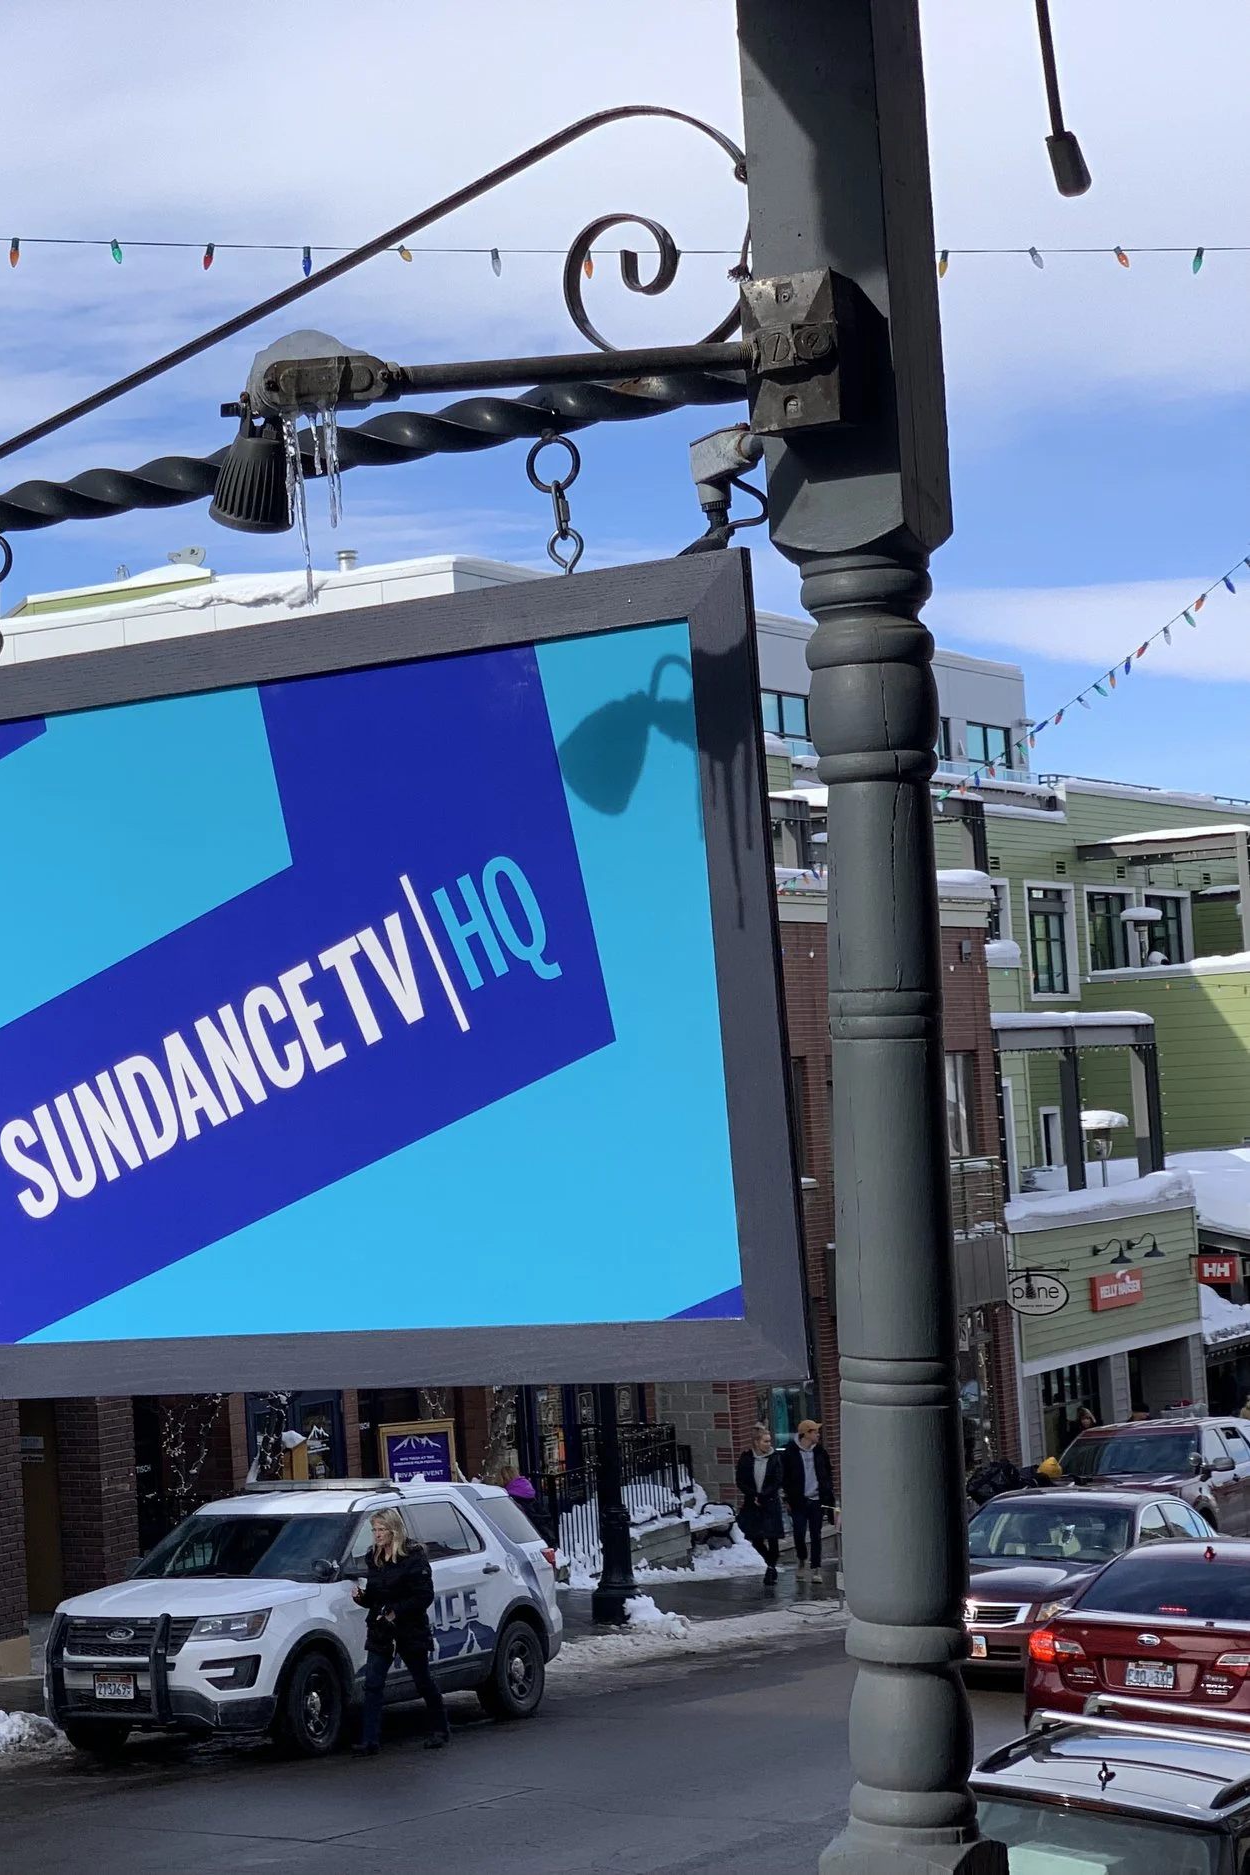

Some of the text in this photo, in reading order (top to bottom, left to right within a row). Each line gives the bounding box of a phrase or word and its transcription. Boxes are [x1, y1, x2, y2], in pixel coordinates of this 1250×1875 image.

[432, 856, 563, 991] HQ
[1203, 1262, 1230, 1278] HH
[434, 1589, 479, 1627] ICE
